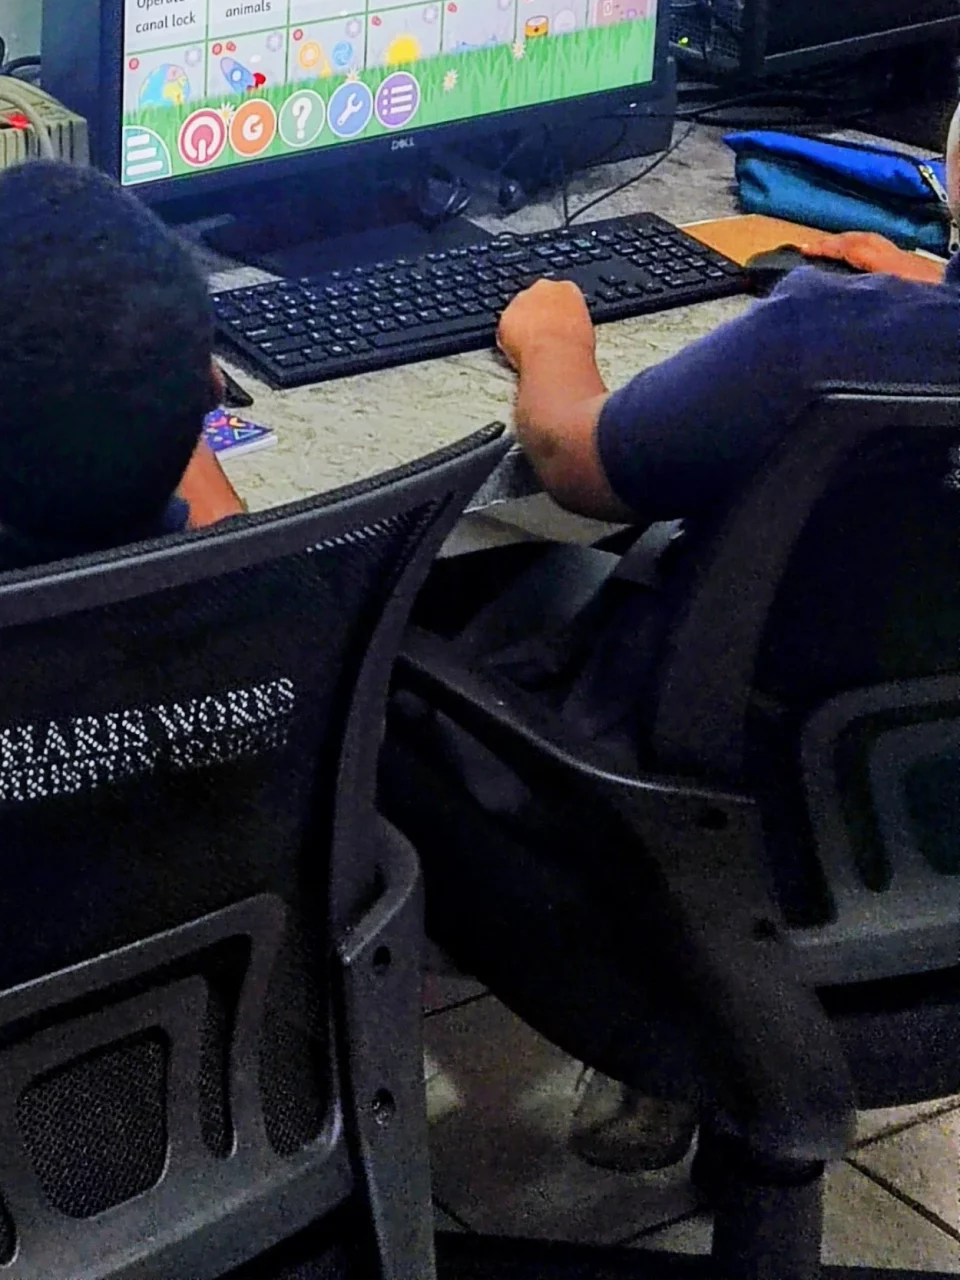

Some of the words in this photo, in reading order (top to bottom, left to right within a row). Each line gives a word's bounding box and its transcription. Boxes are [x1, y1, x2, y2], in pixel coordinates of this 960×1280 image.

[225, 0, 271, 18] animals
[135, 14, 168, 33] canal
[171, 11, 196, 28] lock
[151, 677, 294, 740] WORKS
